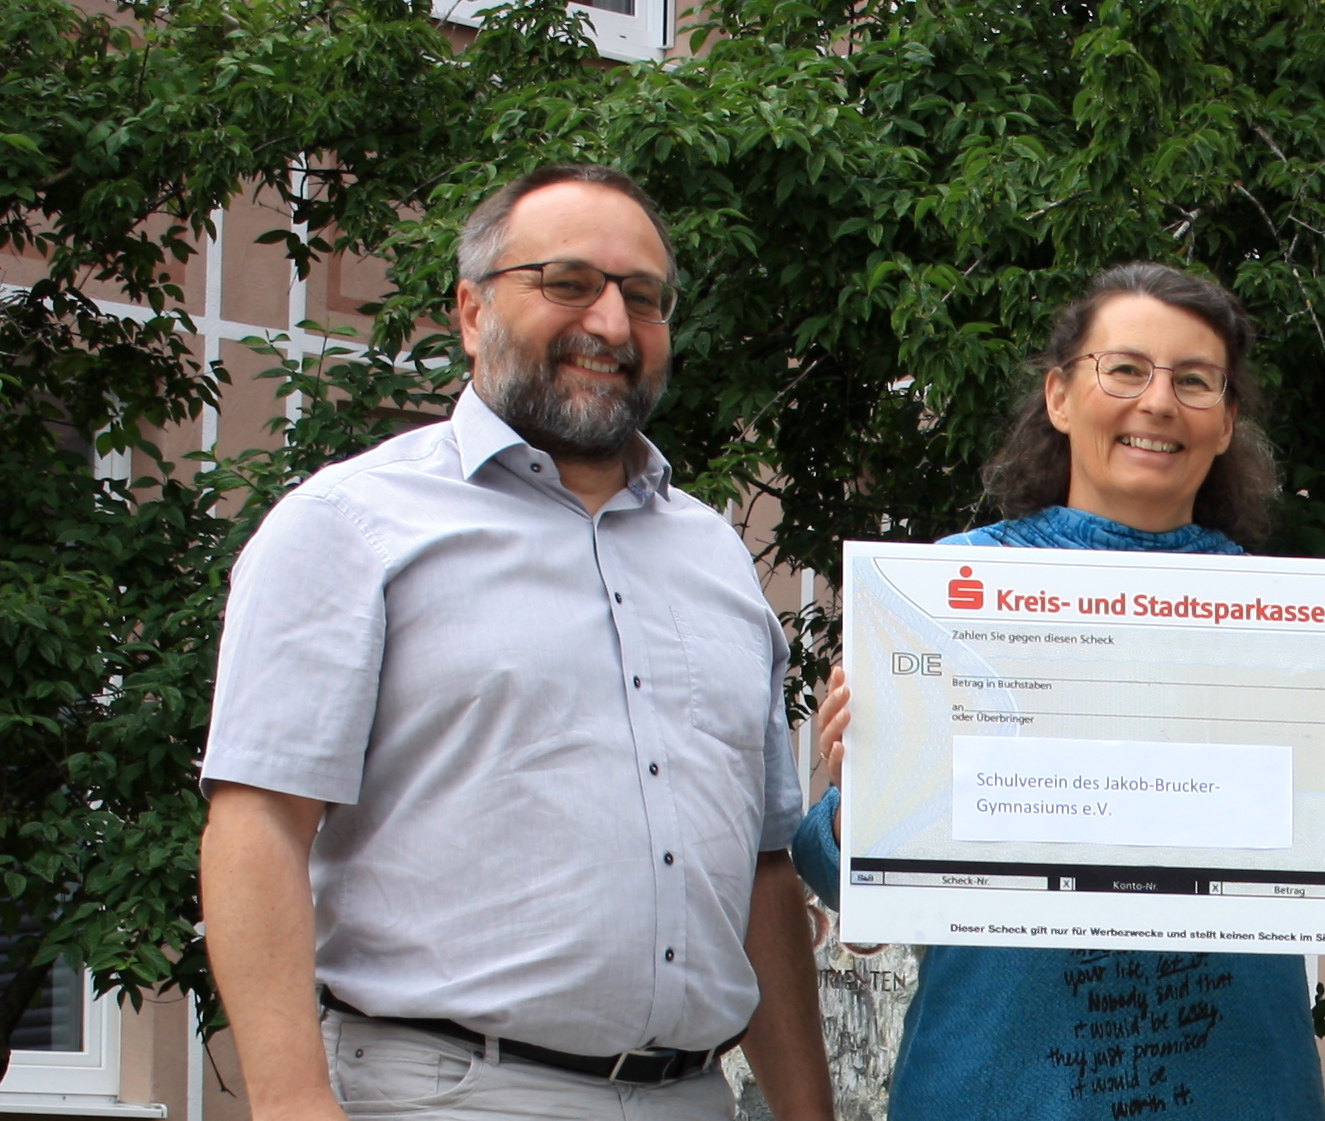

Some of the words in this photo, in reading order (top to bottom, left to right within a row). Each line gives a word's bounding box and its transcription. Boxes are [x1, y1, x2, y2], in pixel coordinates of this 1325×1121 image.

[997, 589, 1070, 613] Kreis-
[1079, 593, 1125, 615] und
[1133, 594, 1325, 624] Stadtsparkasse
[952, 630, 988, 641] Zahlen
[990, 631, 1006, 642] Sie
[1008, 634, 1041, 645] gegen
[1044, 633, 1077, 644] diesen
[1080, 634, 1114, 645] Scheck
[892, 652, 942, 676] DE
[952, 678, 984, 690] Betrag
[986, 679, 996, 689] in
[998, 679, 1052, 690] Buchstaben
[952, 704, 964, 712] an
[952, 713, 974, 722] oder
[977, 712, 1035, 724] Überbringer
[976, 772, 1068, 790] Schulverein
[1073, 774, 1099, 790] des
[1104, 776, 1221, 793] Jakob-Brucker-
[976, 798, 1078, 817] Gymnasiums
[1082, 802, 1113, 817] e.V.
[941, 876, 991, 887] Scheck-Nr.
[1113, 881, 1159, 892] Konto-Nr.
[1274, 885, 1306, 897] Betrag
[950, 924, 985, 934] Dieser
[988, 924, 1027, 935] Scheck
[1050, 928, 1068, 936] nur
[1071, 927, 1087, 936] für
[1090, 927, 1164, 938] Werbezwecke
[1167, 930, 1187, 939] und
[1190, 930, 1217, 940] stellt
[1219, 931, 1255, 941] keinen
[1258, 932, 1297, 942] Scheck
[1300, 934, 1312, 942] im
[1063, 965, 1107, 997] your
[1087, 985, 1149, 1021] Nobody
[1155, 973, 1190, 1005] said
[1195, 971, 1235, 993] that
[1090, 1015, 1141, 1039] would
[1151, 1011, 1169, 1032] be
[1047, 1047, 1087, 1078] they
[1091, 1044, 1125, 1073] just
[1133, 1033, 1208, 1070] promised
[1070, 1078, 1087, 1100] it
[1091, 1069, 1140, 1094] would
[1111, 1094, 1166, 1121] worth
